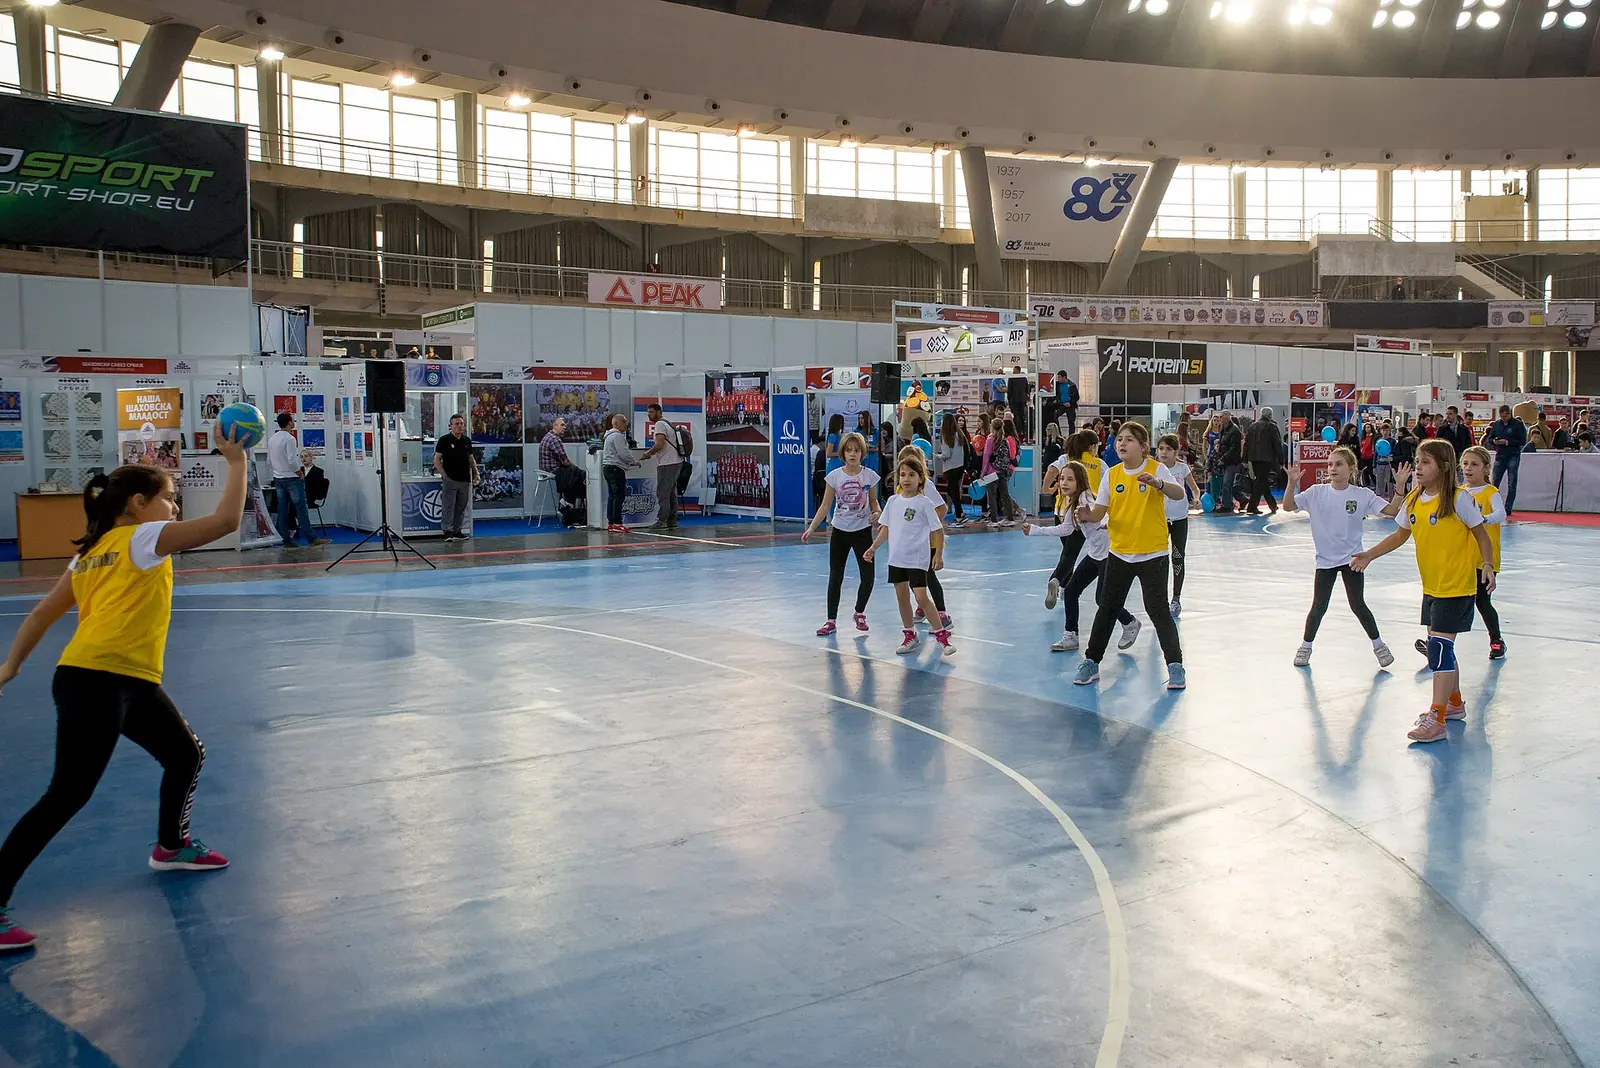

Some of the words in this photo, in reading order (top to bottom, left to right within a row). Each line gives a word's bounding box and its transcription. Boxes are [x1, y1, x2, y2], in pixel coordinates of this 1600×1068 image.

[996, 165, 1021, 177] 1937
[1001, 189, 1025, 200] 1957
[1005, 211, 1031, 223] 2017
[641, 281, 706, 308] PEAK
[1008, 330, 1024, 342] ATP
[1010, 355, 1021, 363] ATP
[136, 394, 161, 404] НАША
[125, 402, 172, 413] ШАХОВСКА
[128, 411, 169, 421] МЛАДОСТ
[777, 443, 805, 455] UNIQA
[1303, 450, 1309, 458] У
